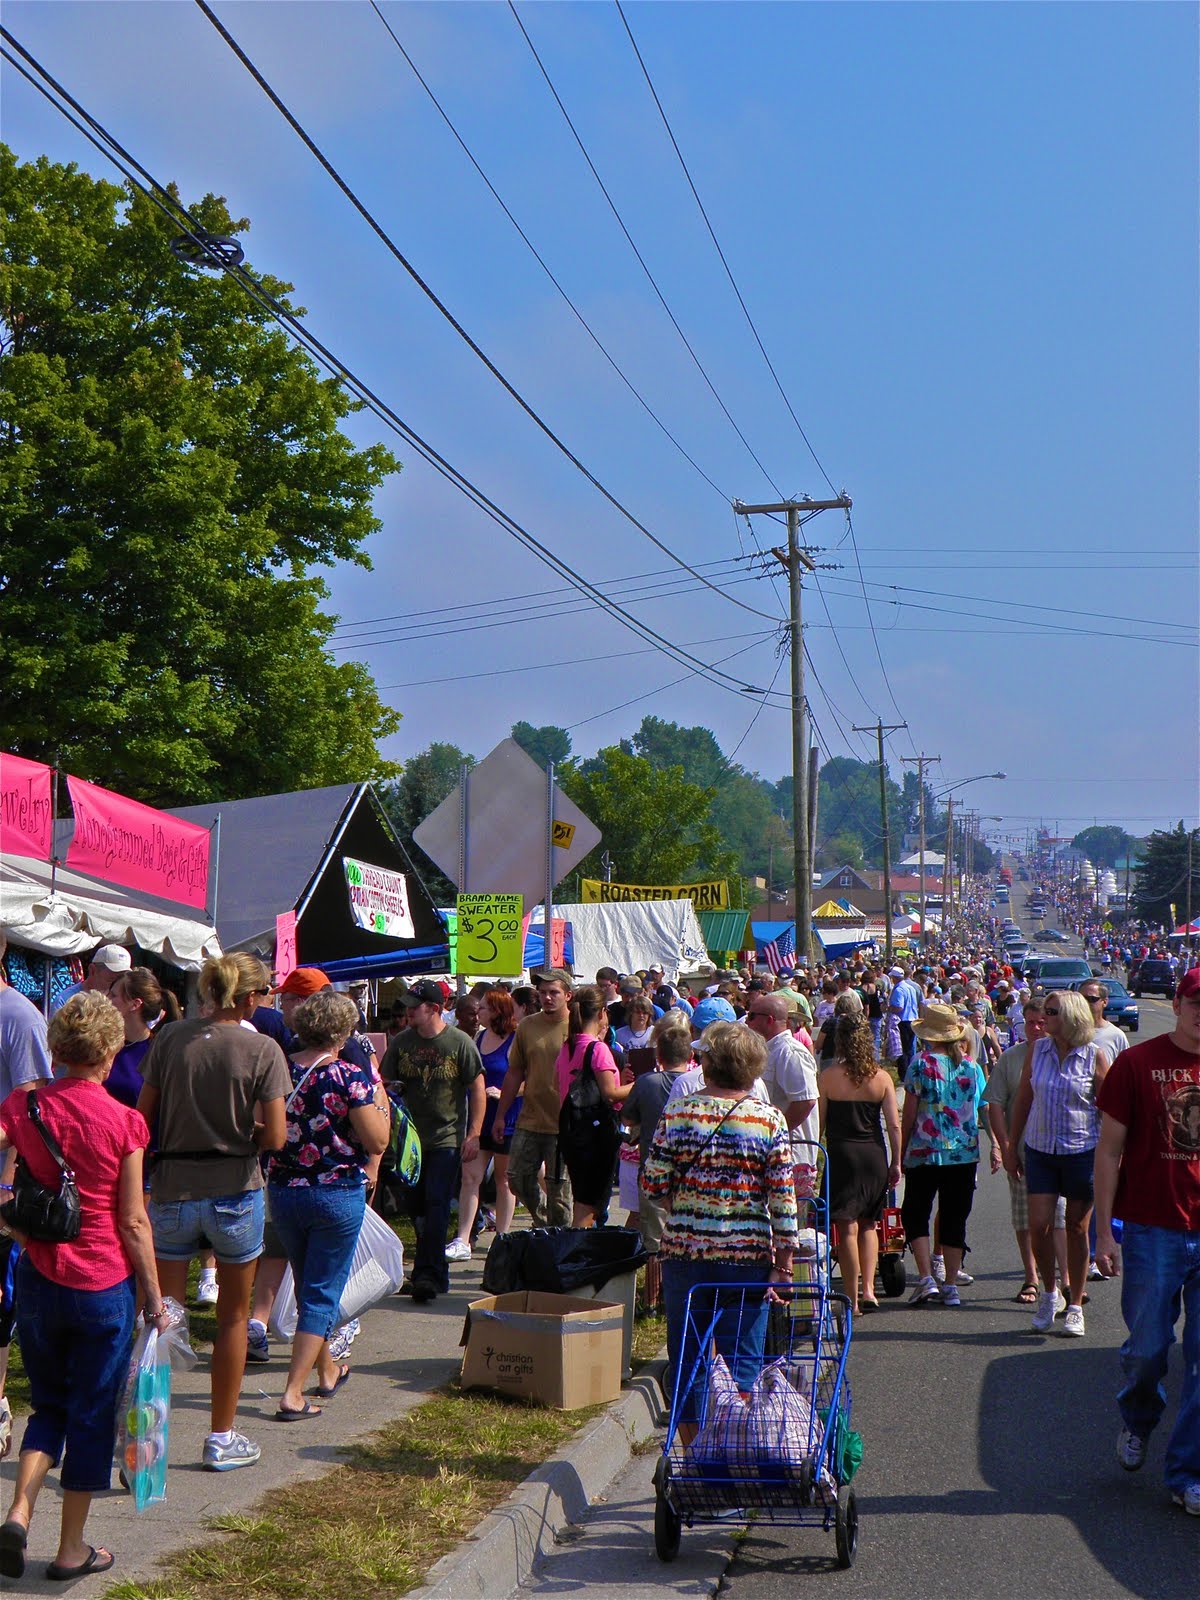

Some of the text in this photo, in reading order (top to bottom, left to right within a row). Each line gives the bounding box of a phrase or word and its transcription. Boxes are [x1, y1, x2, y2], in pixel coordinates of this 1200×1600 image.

[0, 778, 49, 846] welry
[72, 800, 156, 869] Monogrammed
[157, 826, 178, 887] Bags
[187, 844, 207, 896] Gifts
[459, 894, 520, 903] BRAND NAME
[601, 883, 721, 906] ROASTED CORN
[458, 904, 516, 916] SWEATER
[1151, 1068, 1194, 1083] BUCK
[496, 1352, 533, 1364] christian
[514, 1365, 534, 1376] gifts
